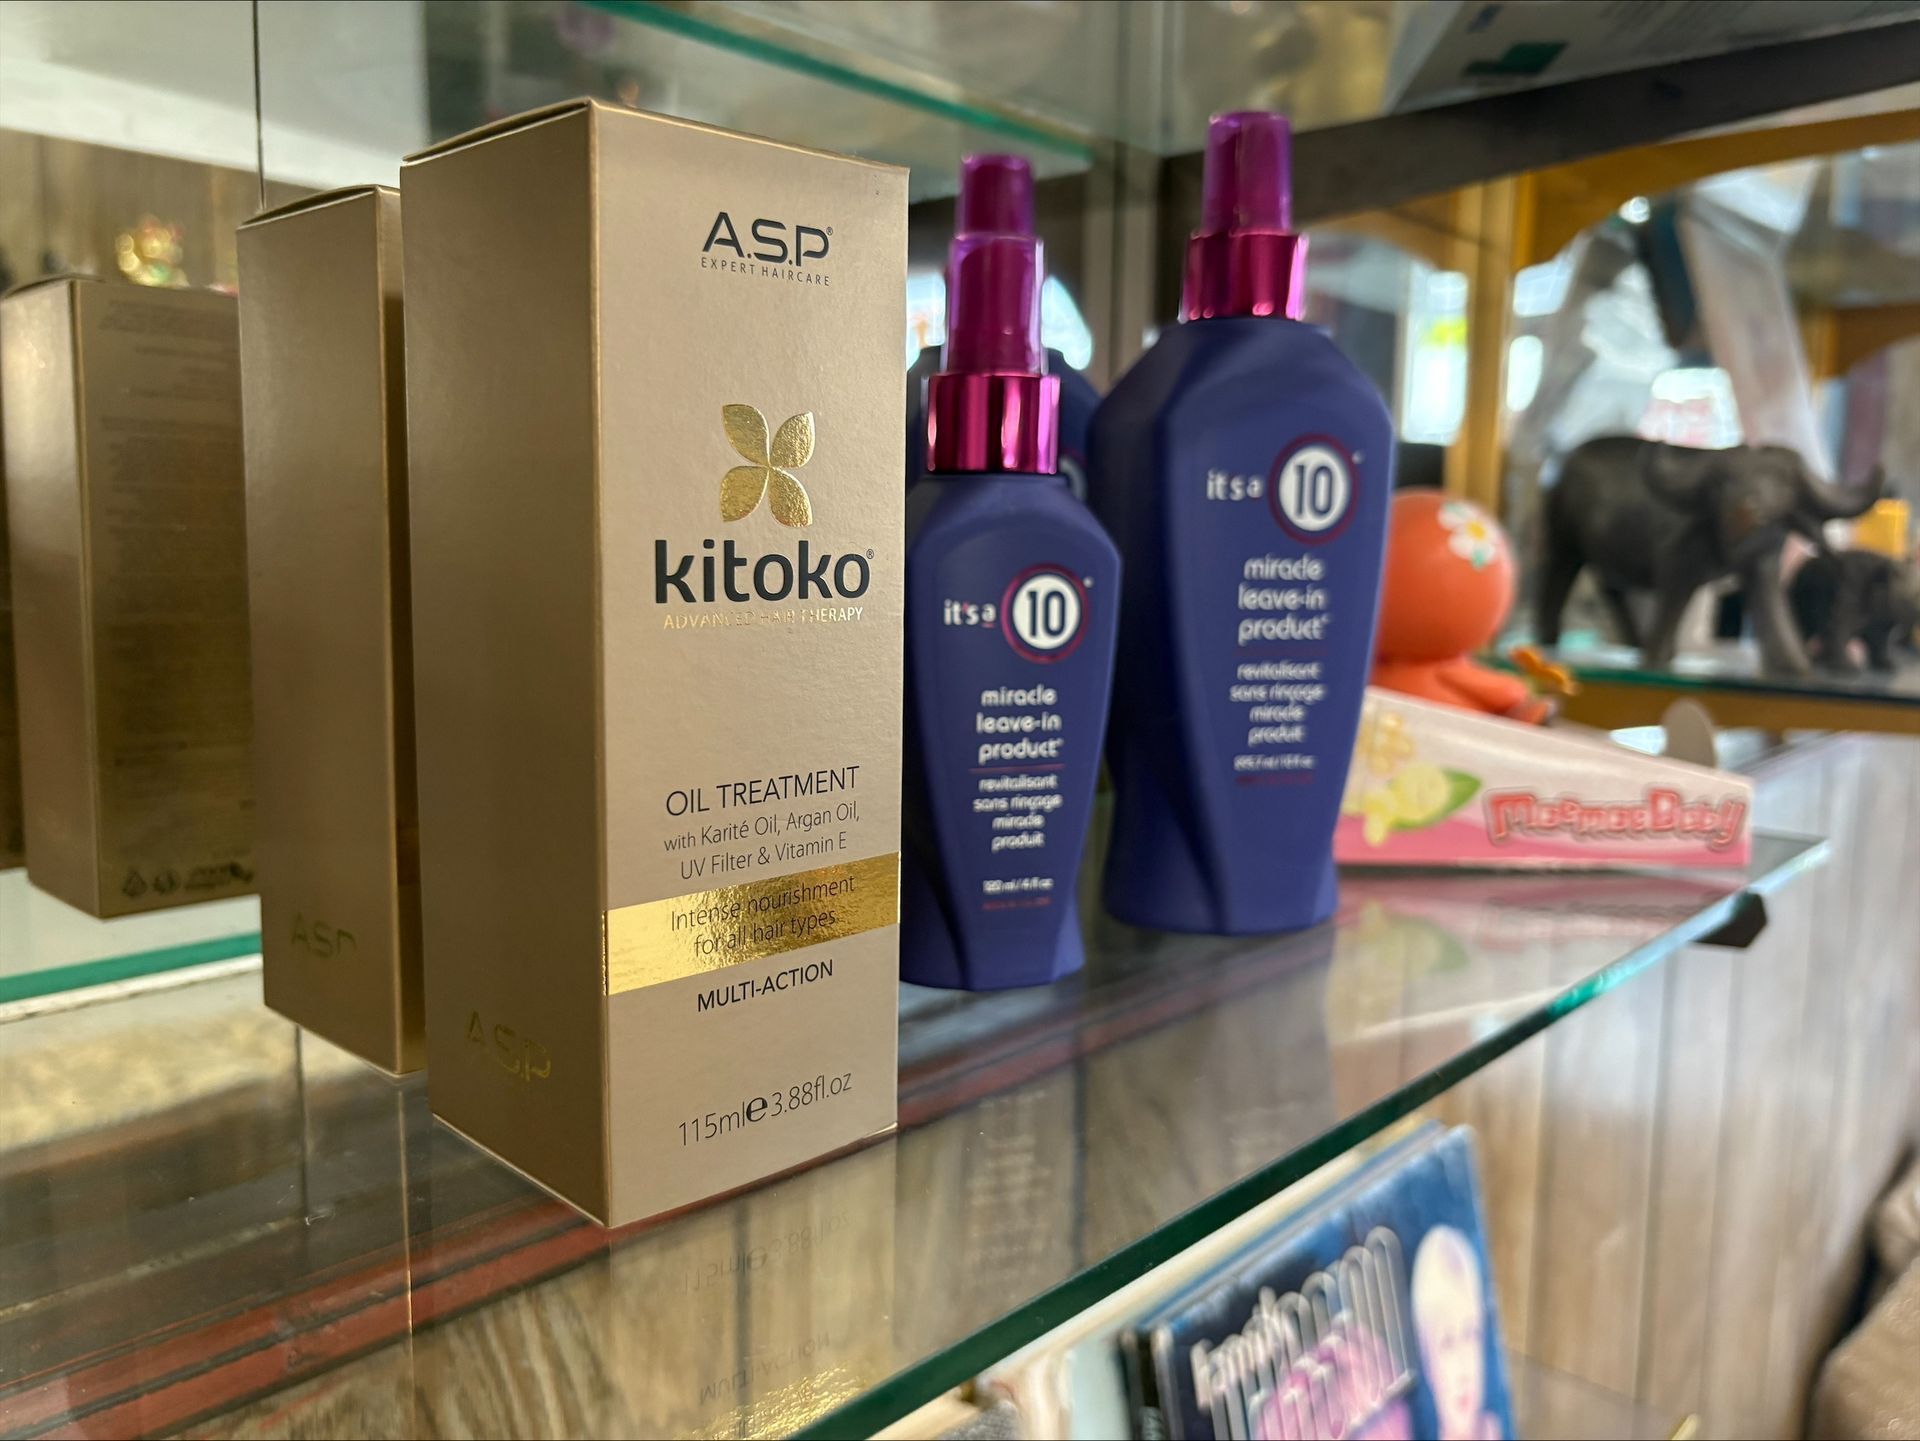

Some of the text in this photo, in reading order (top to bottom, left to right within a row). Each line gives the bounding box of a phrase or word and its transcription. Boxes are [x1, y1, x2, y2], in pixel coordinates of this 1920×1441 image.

[700, 256, 831, 287] EXPERT HAIRCARE
[1243, 552, 1326, 582] miracle
[1237, 581, 1329, 611] leave-in
[799, 606, 864, 624] THERAPY
[981, 602, 997, 629] a
[980, 684, 1058, 708] miracle
[975, 711, 1063, 735] leave-in
[666, 765, 860, 817] OIL TREATMENT
[664, 800, 860, 851] with Karité Oil, Argan Oil,
[680, 831, 848, 880] UV Filter & Vitamin E
[671, 876, 856, 931] Intense nourishment
[693, 910, 837, 957] for all hair types
[697, 959, 834, 1012] MULTI-ACTION
